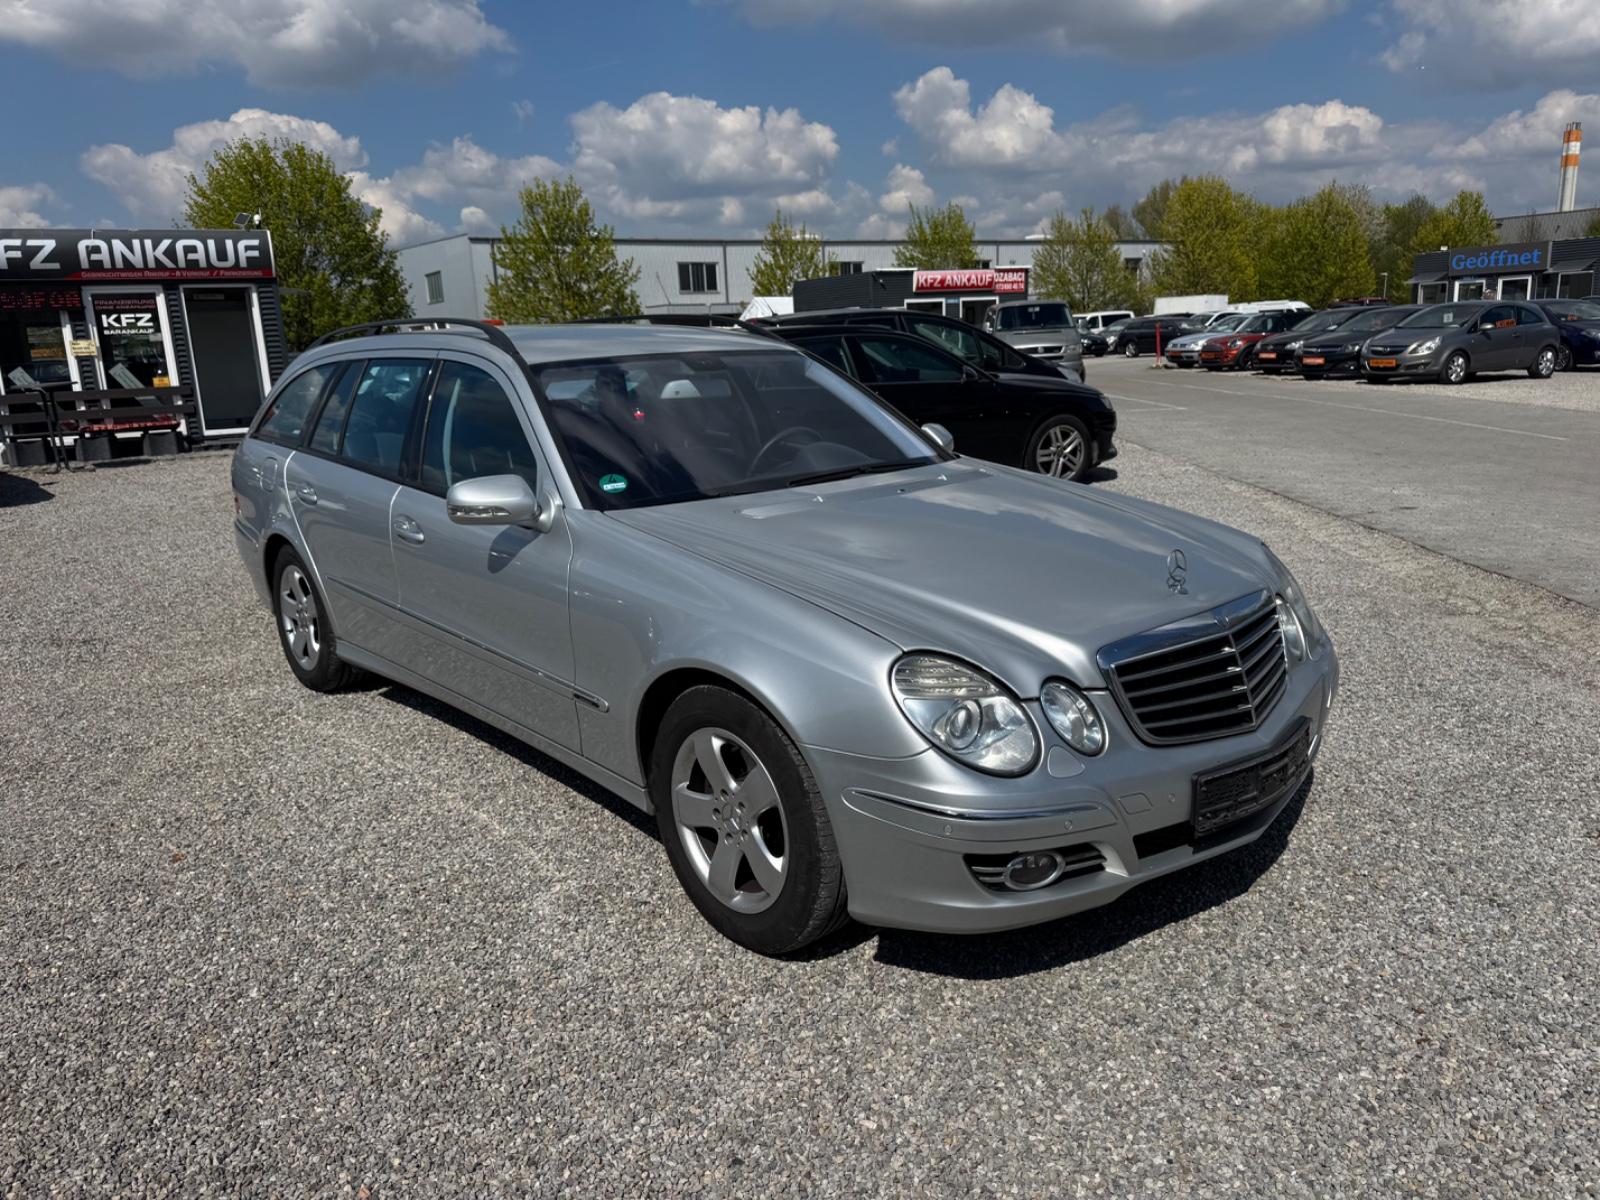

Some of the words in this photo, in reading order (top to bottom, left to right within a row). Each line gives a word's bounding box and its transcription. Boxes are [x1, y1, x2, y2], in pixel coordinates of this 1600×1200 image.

[77, 239, 260, 269] ANKAUF
[1452, 249, 1542, 270] Geöffnet
[918, 274, 942, 288] KFZ
[944, 273, 993, 287] ANKAUF
[101, 312, 154, 328] KFZ
